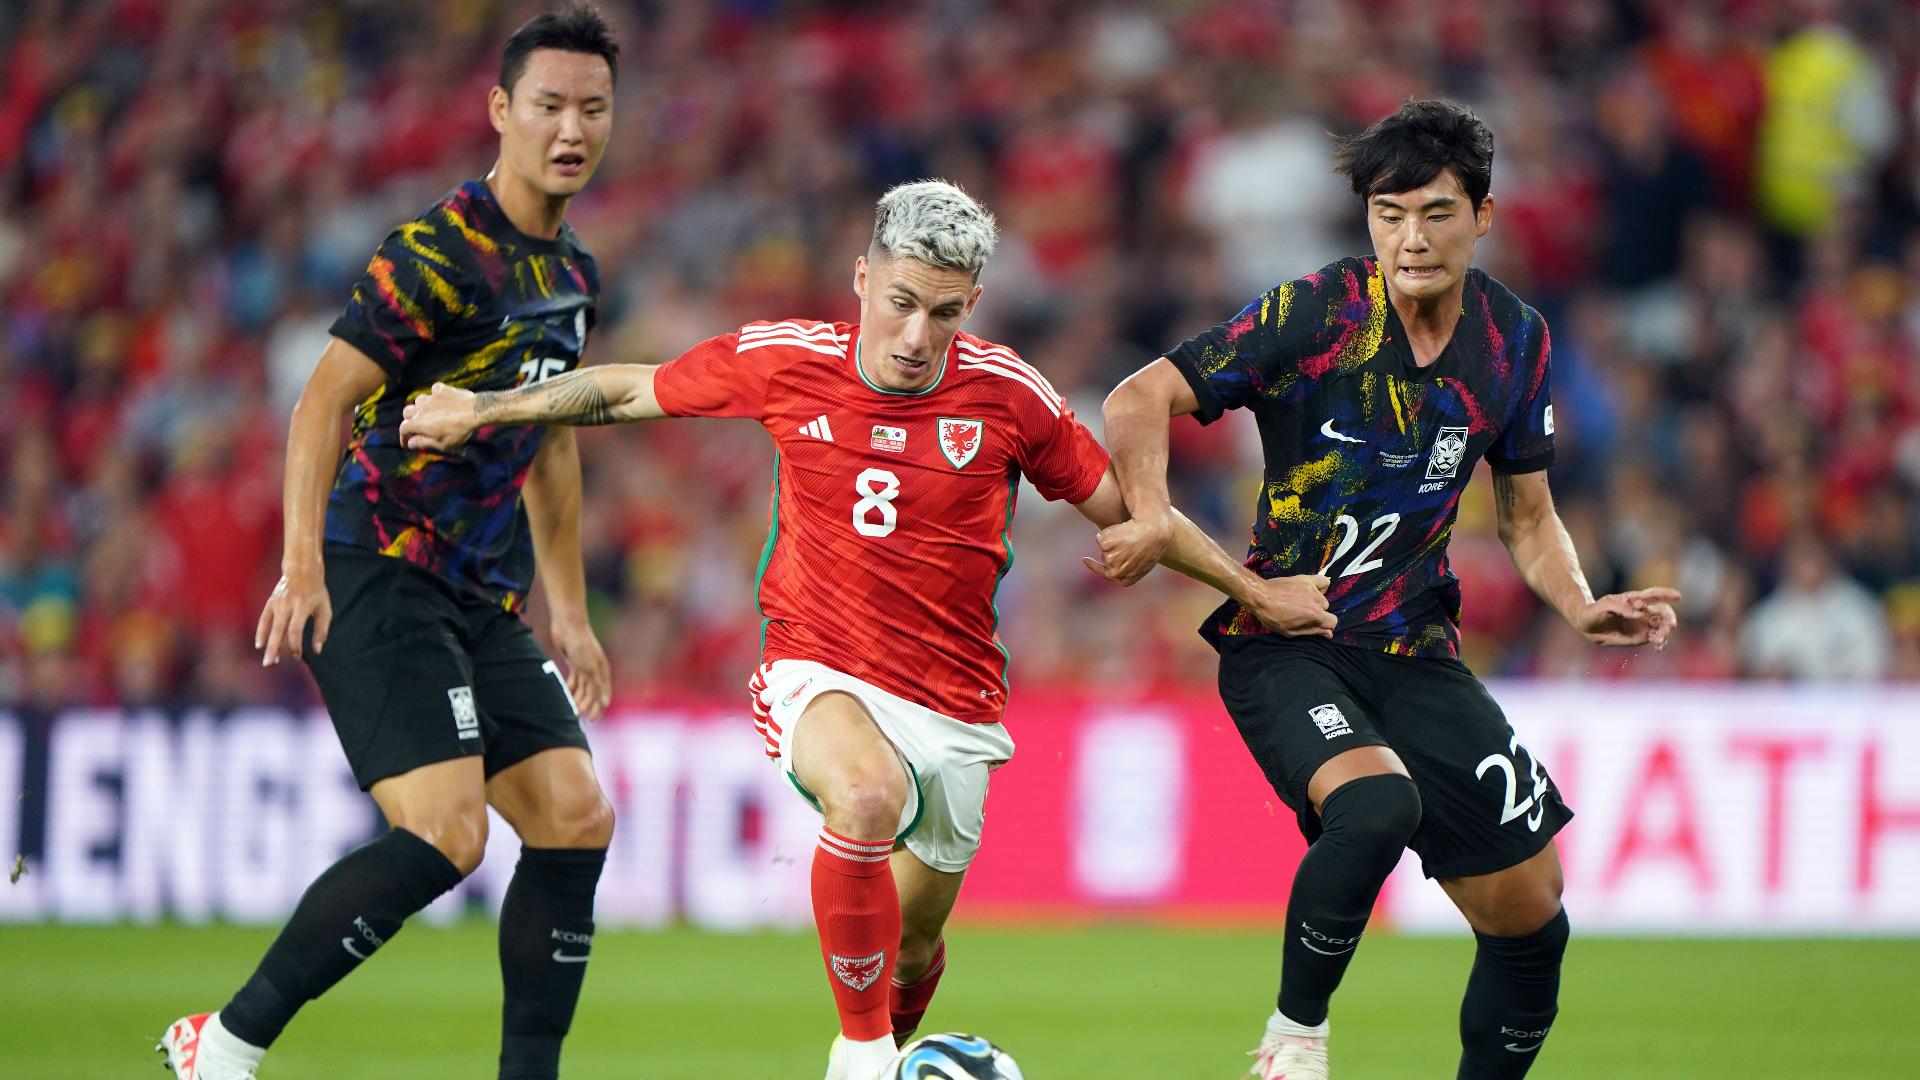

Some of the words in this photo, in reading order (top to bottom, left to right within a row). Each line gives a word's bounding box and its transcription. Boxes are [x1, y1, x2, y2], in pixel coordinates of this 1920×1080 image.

[852, 467, 901, 538] 8
[1319, 512, 1401, 578] 22
[1548, 730, 1920, 898] ATH
